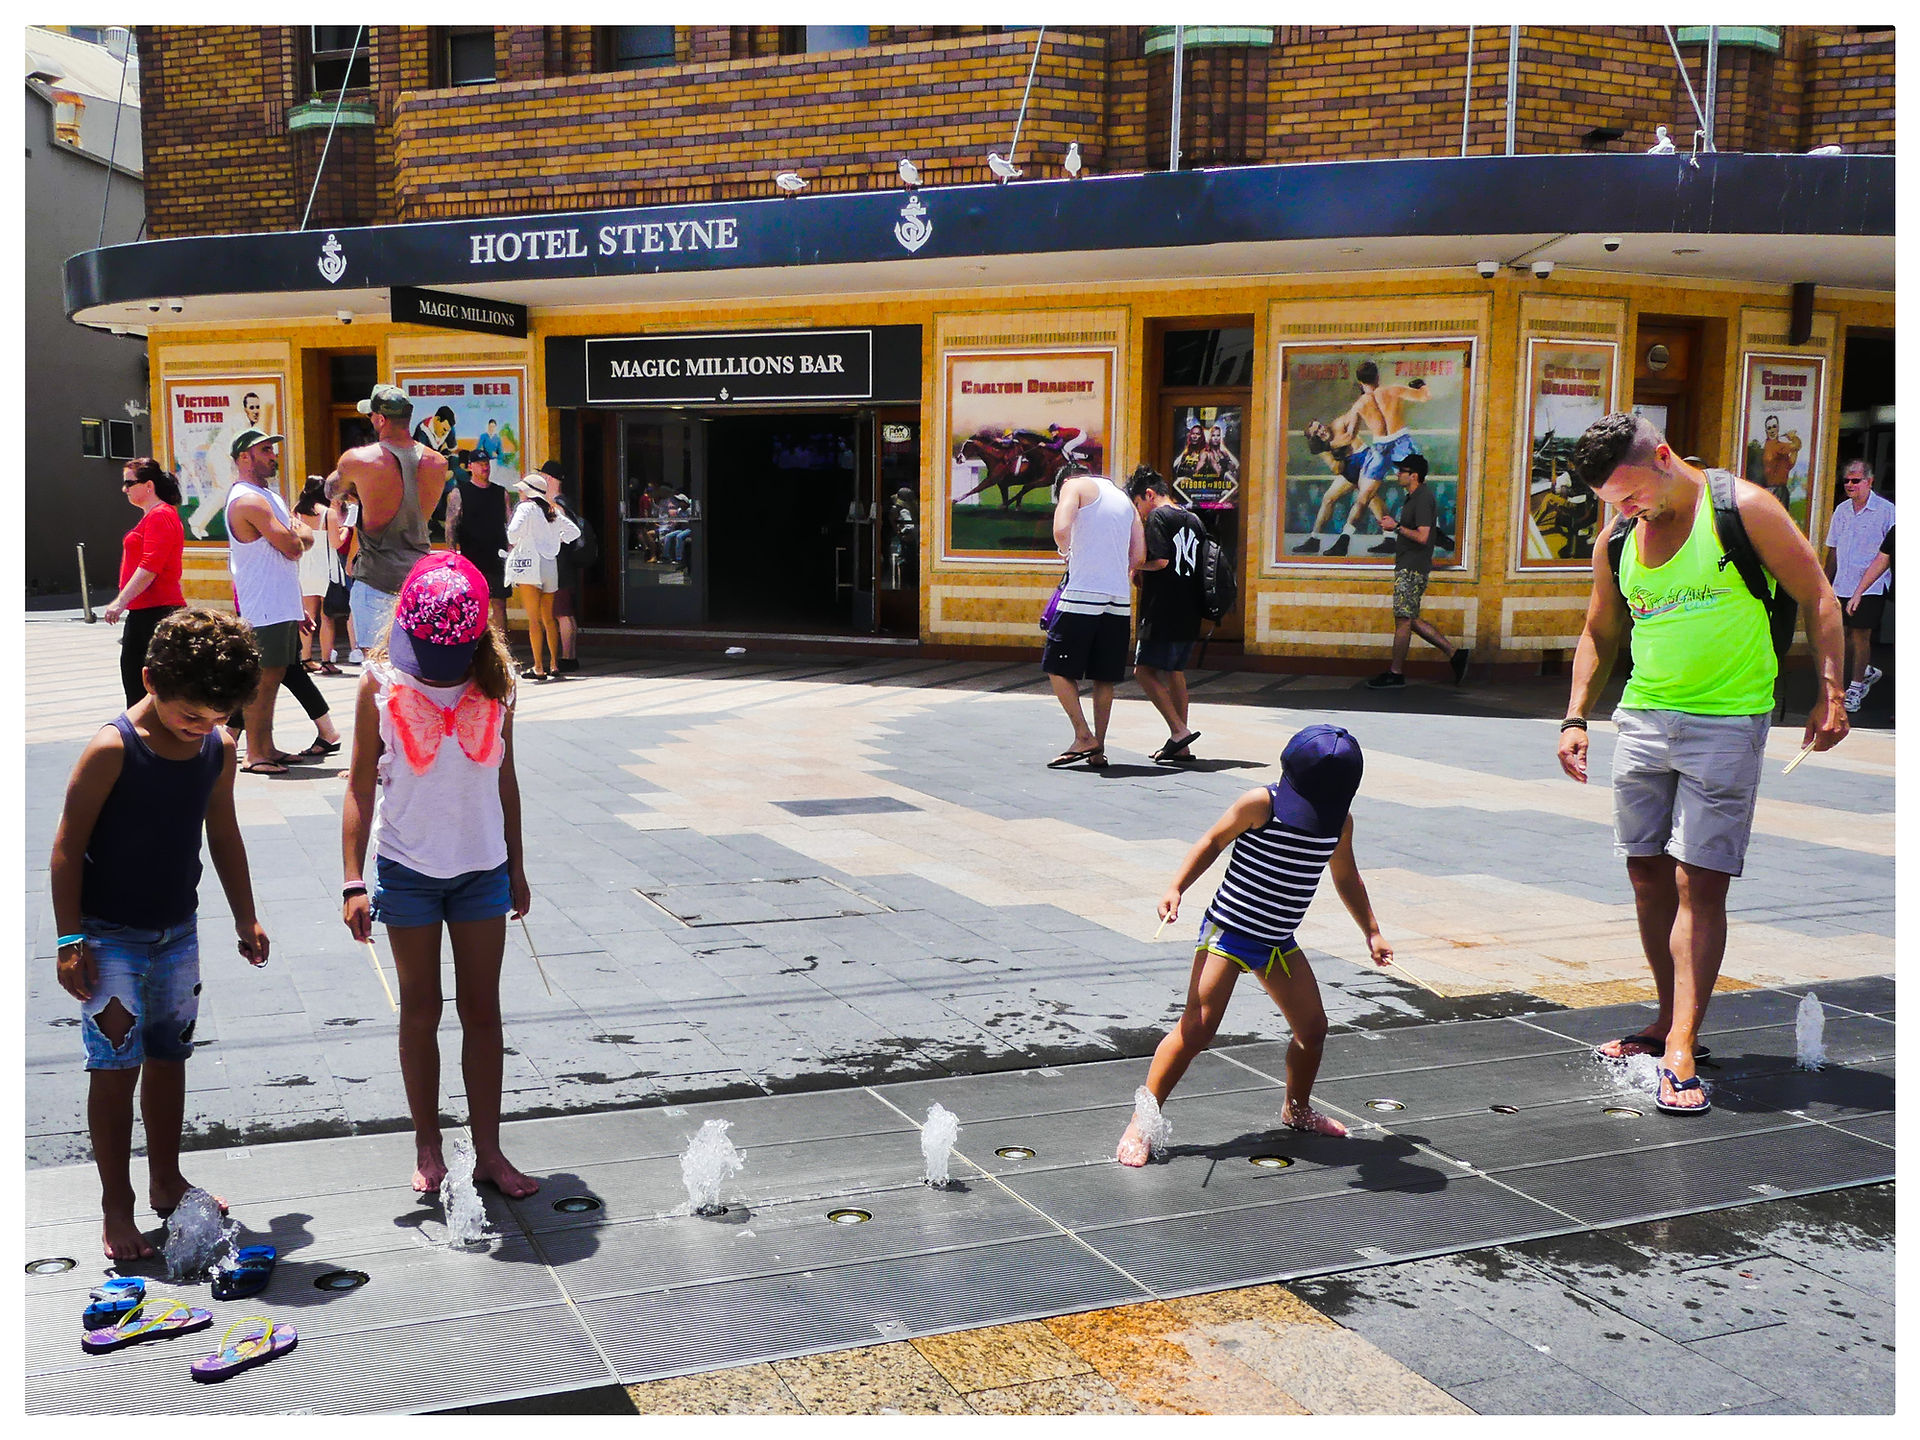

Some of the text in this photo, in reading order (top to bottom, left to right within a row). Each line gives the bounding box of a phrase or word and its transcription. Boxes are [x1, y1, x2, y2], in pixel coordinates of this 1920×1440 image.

[470, 218, 738, 264] HOTEL STEYNE
[419, 300, 515, 327] MAGIC MILLIONS
[610, 354, 845, 378] MAGIC MILLIONS BAR
[961, 379, 1095, 394] CARLTON DRAUGHT
[1762, 370, 1808, 387] CROWN
[175, 394, 230, 409] VICTORIA
[1765, 386, 1803, 401] LAGER
[184, 409, 223, 423] BITTER
